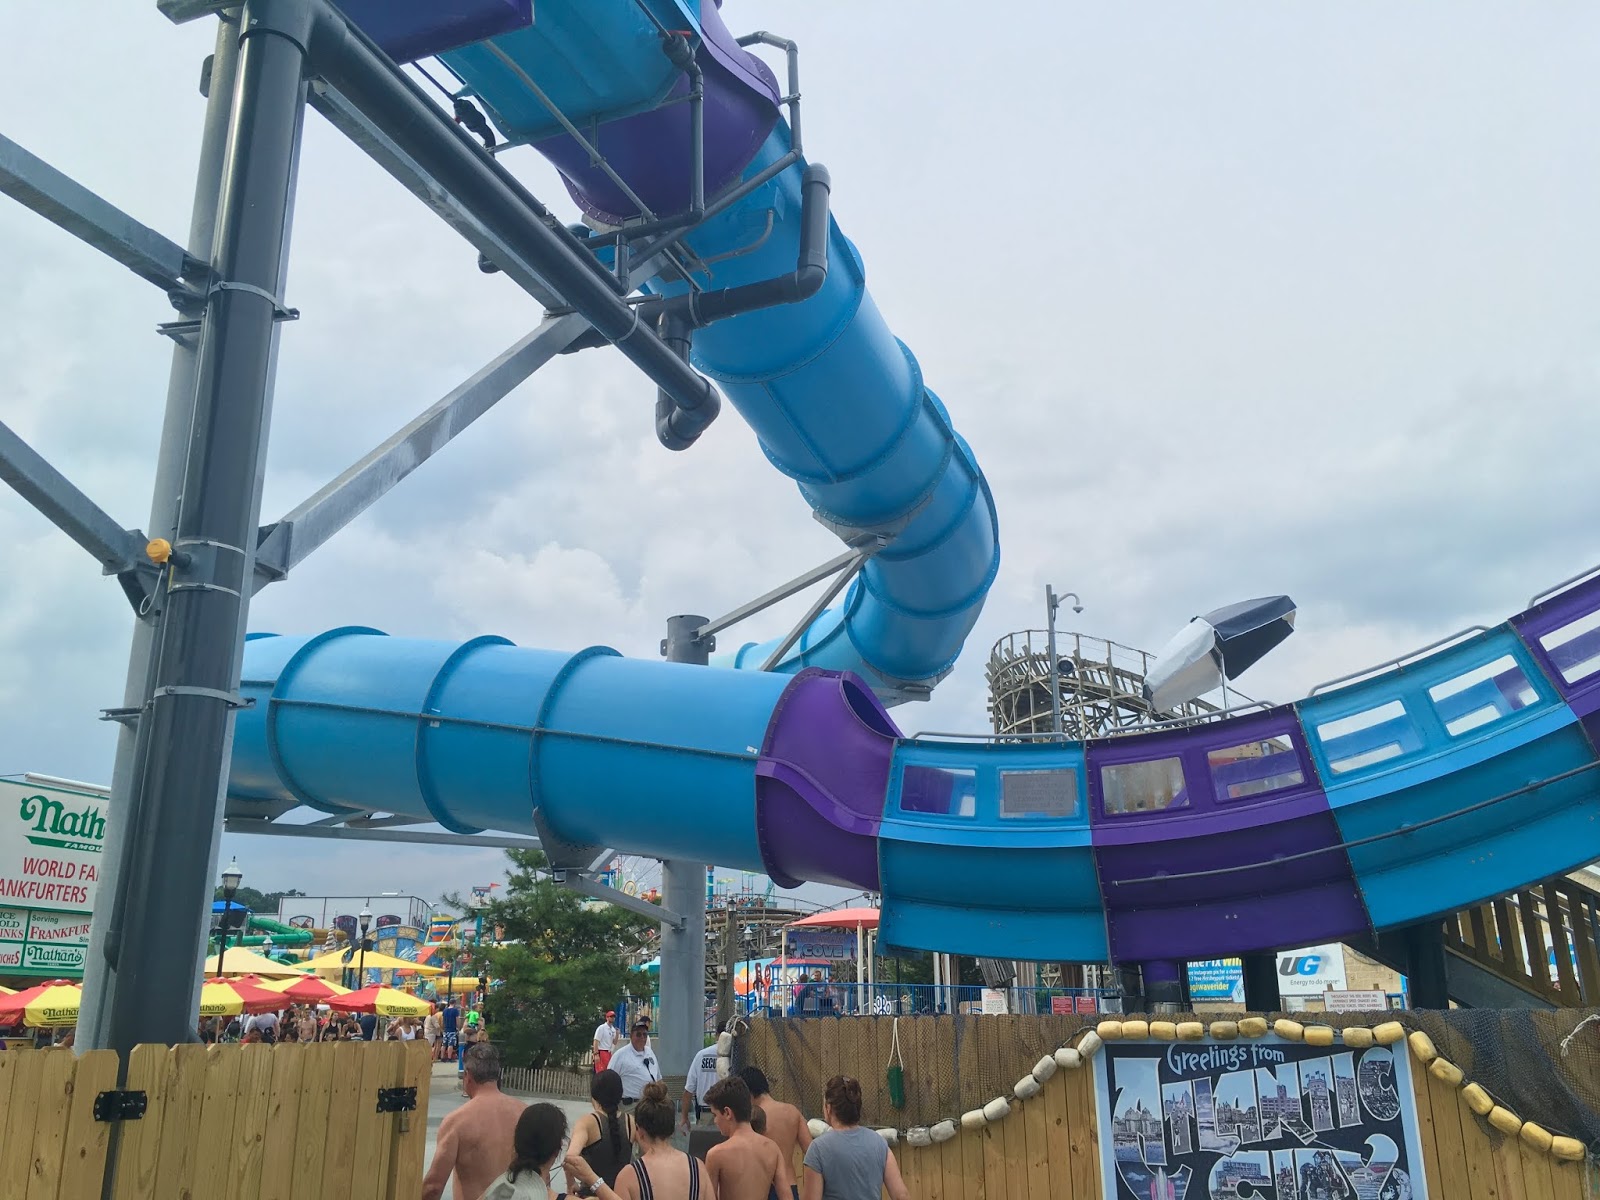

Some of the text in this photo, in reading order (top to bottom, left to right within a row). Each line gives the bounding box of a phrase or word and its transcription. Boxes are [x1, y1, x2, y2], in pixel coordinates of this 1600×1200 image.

[20, 795, 106, 840] Nath
[23, 857, 99, 882] WORLD FA
[31, 914, 59, 925] Serving
[29, 924, 91, 940] FRANKFUR
[27, 946, 84, 963] Nathan's
[802, 943, 844, 958] COVE
[386, 1005, 418, 1013] Nathan's
[1167, 1043, 1285, 1075] Greetings from
[1112, 1047, 1401, 1165] ATLANTIC
